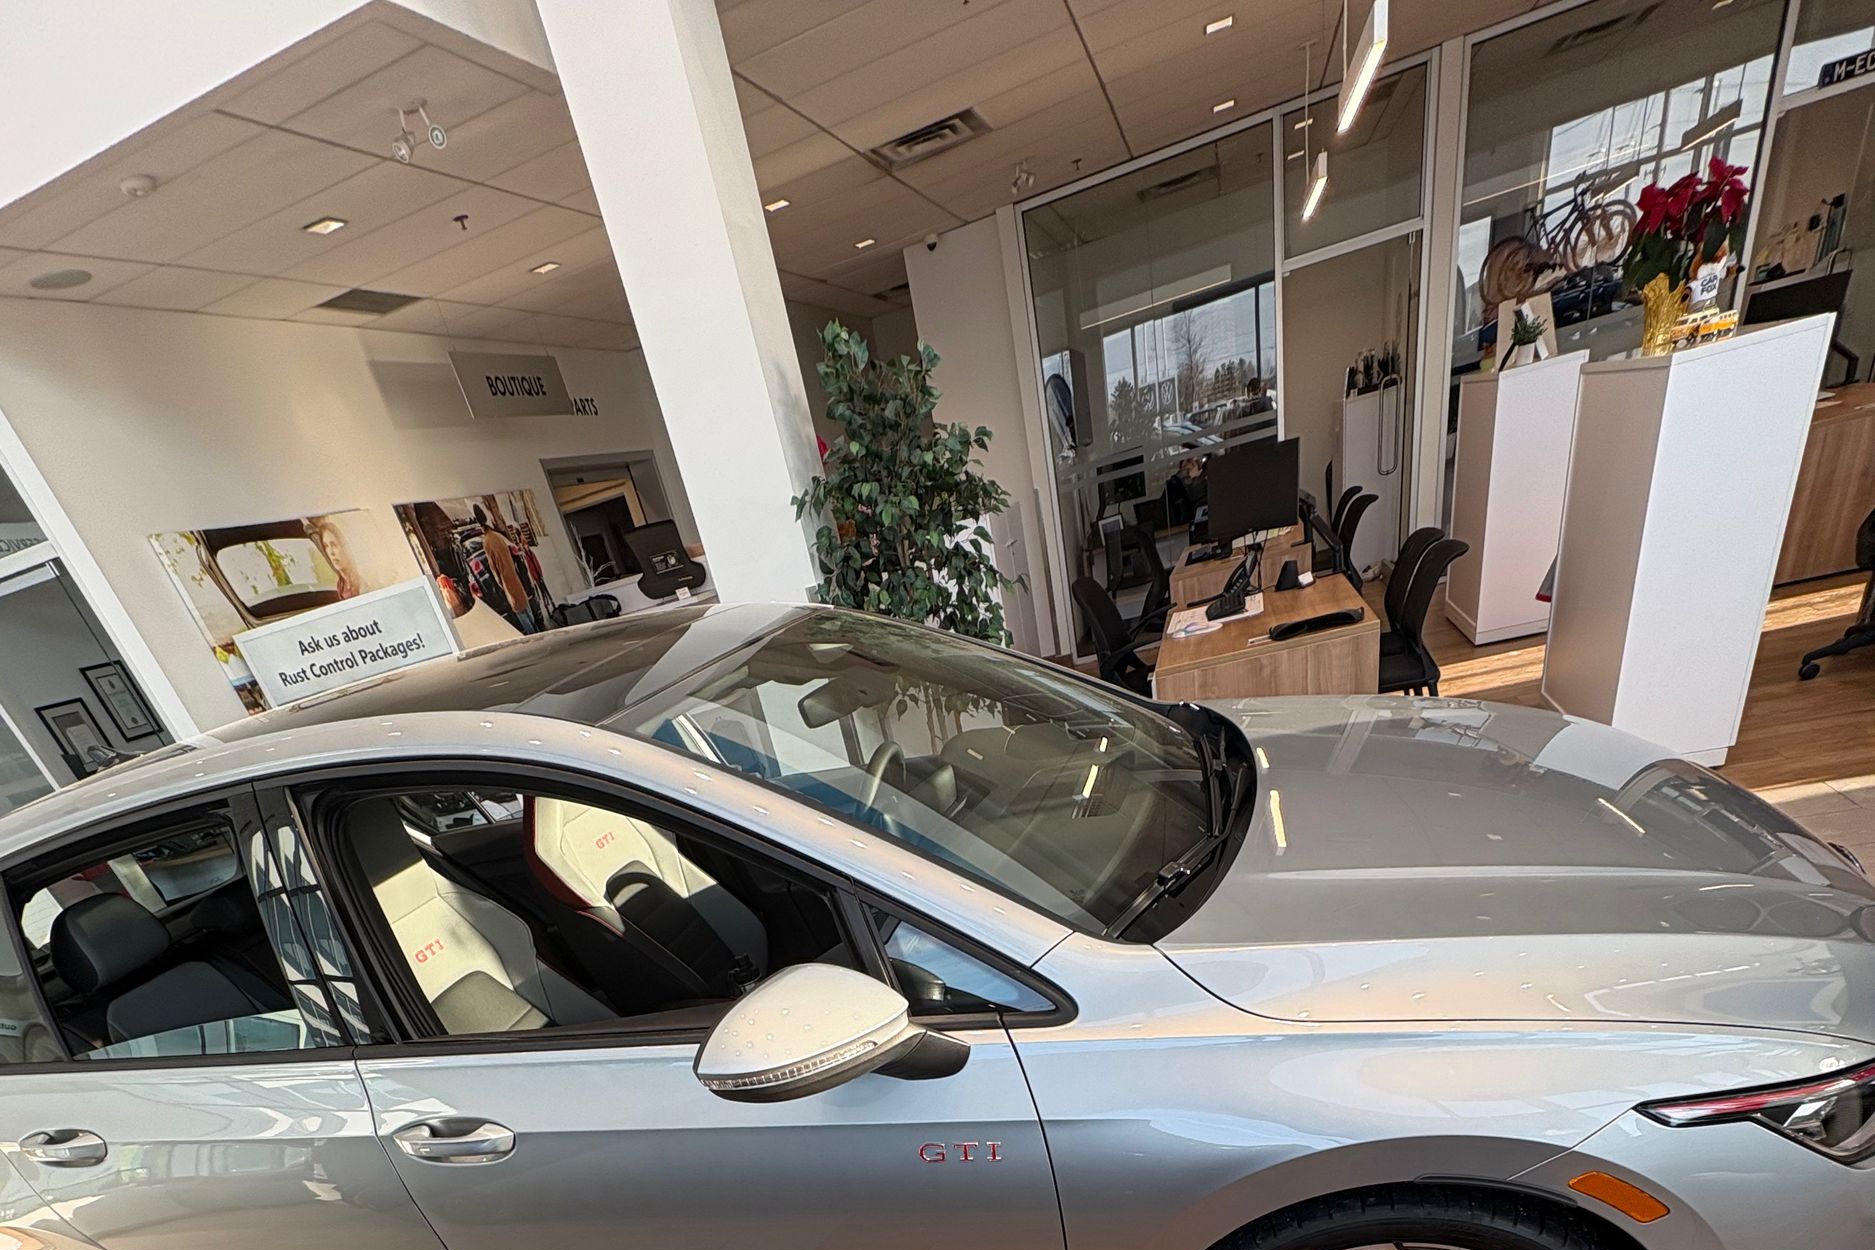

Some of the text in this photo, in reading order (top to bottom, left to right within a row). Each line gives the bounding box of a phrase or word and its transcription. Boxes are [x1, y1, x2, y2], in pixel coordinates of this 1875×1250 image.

[1700, 274, 1718, 287] CAR
[1700, 283, 1717, 295] FOX
[485, 376, 547, 397] BOUTIQUE
[571, 398, 599, 416] ARTS
[298, 619, 382, 656] Ask us about
[278, 633, 426, 687] Rust Control Packages!
[595, 831, 615, 849] GTI
[415, 939, 444, 964] GTI
[918, 1141, 1002, 1163] GTI
